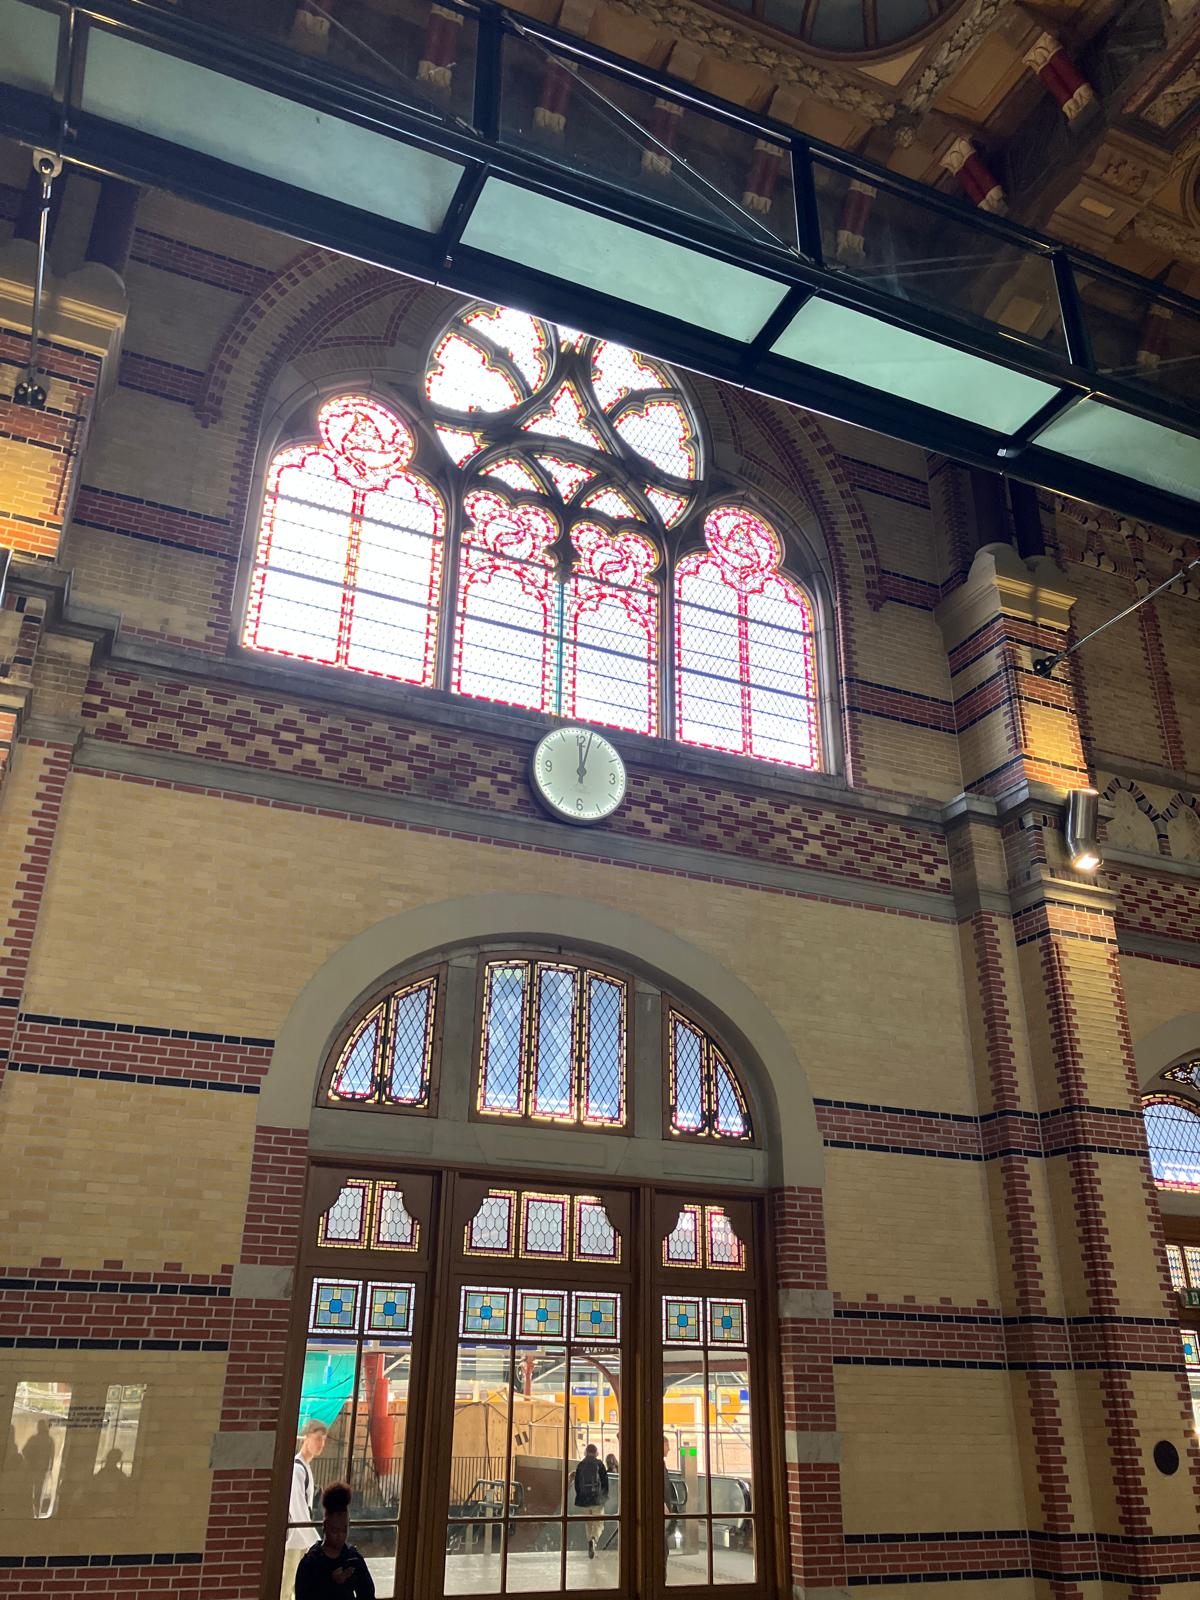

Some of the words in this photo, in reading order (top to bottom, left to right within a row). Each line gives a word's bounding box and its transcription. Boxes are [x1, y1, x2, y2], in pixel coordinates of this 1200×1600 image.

[576, 735, 586, 748] 12
[545, 760, 552, 772] 9
[609, 773, 616, 785] 3
[576, 798, 583, 811] 6
